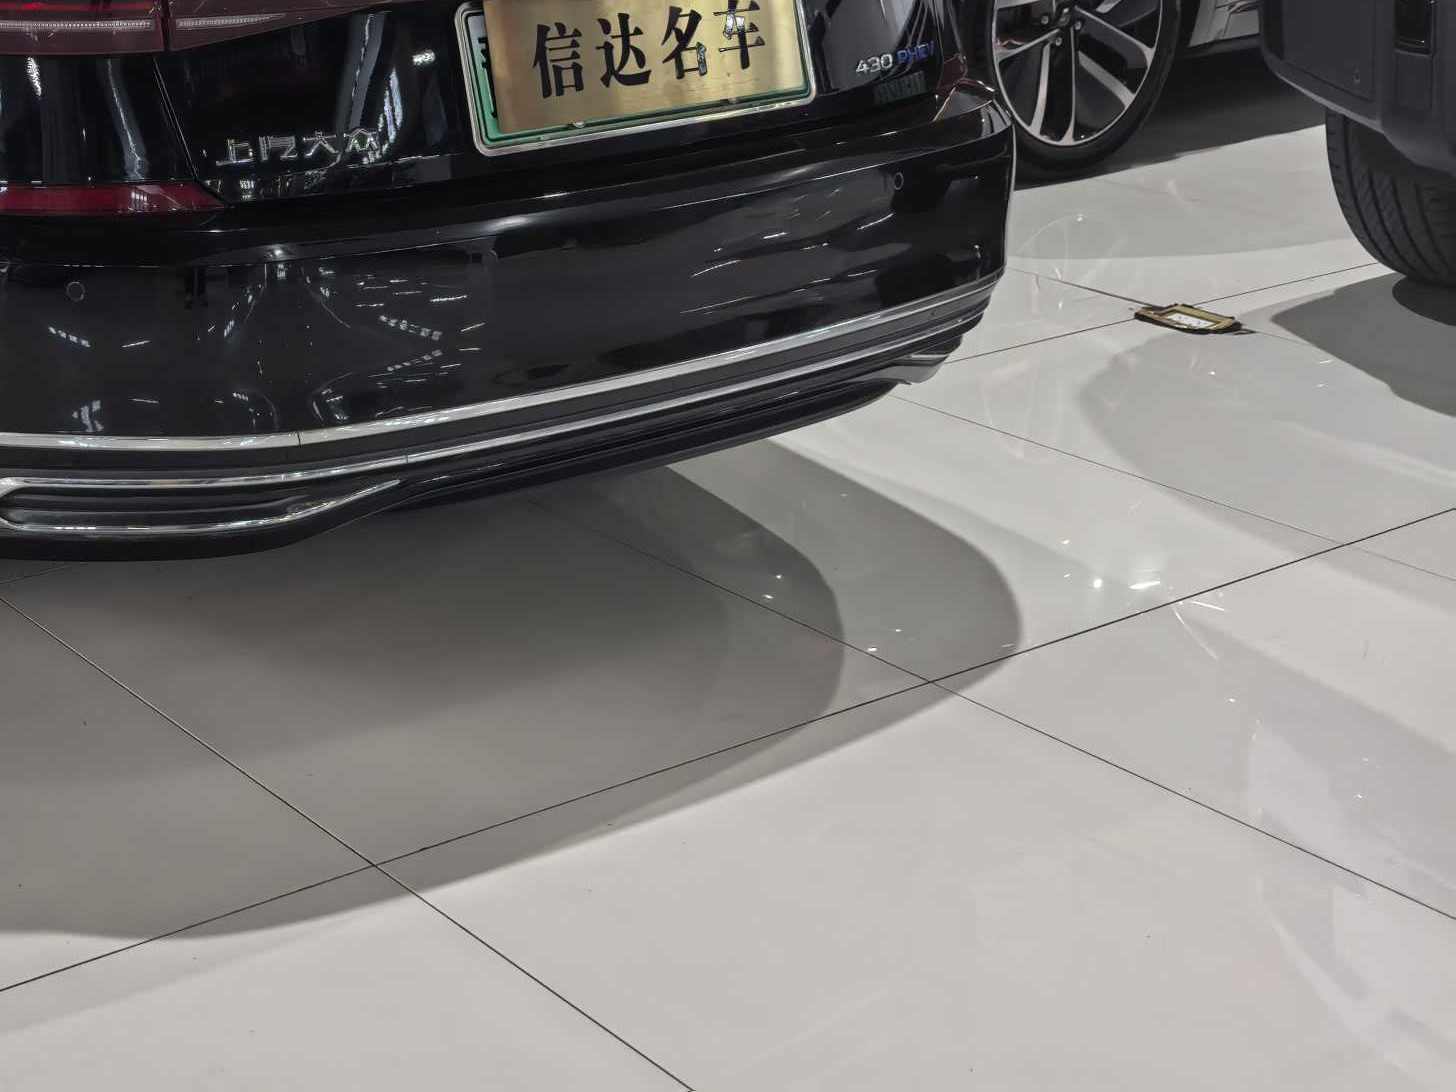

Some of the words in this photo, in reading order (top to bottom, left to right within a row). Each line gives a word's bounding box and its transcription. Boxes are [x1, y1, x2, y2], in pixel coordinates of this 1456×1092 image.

[855, 53, 894, 74] 430
[215, 129, 382, 167] 上汽大众
